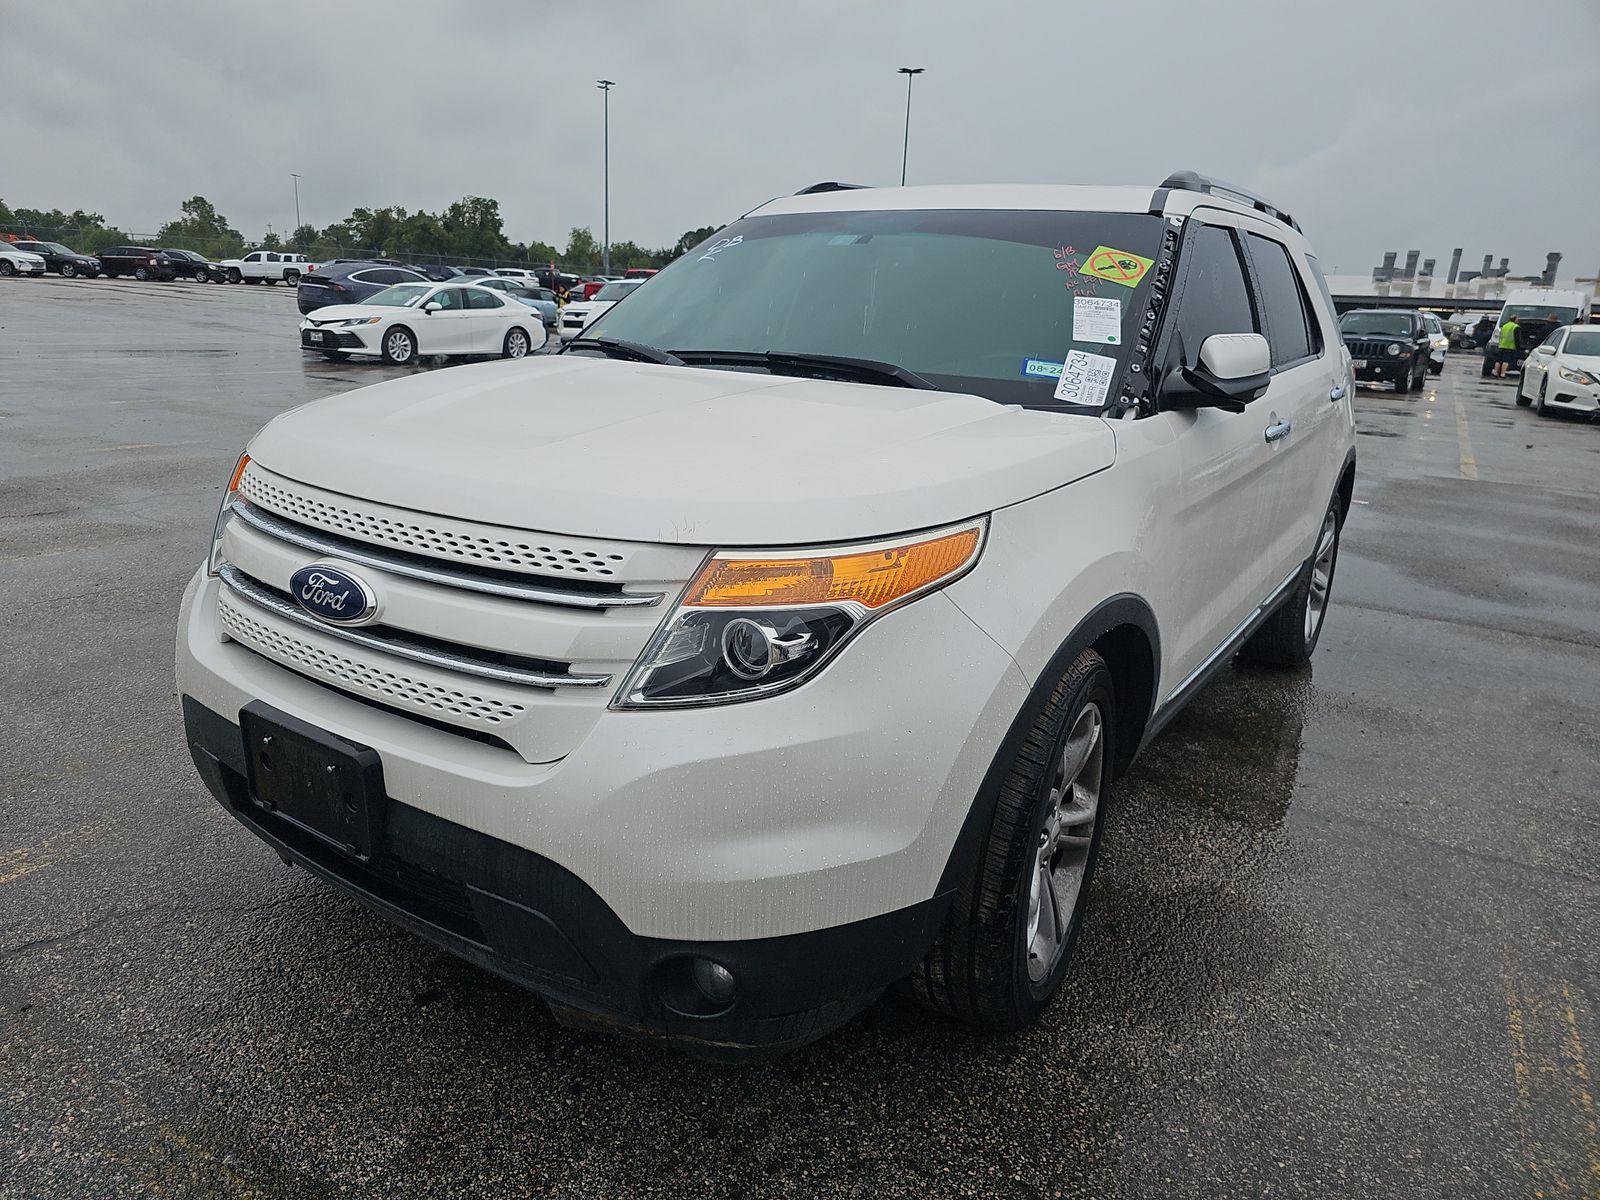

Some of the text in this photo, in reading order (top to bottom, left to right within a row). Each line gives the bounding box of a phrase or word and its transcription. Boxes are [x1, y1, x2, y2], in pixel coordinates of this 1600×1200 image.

[1073, 299, 1119, 307] 3064734
[1060, 353, 1089, 398] 3064734
[302, 572, 350, 611] Ford
